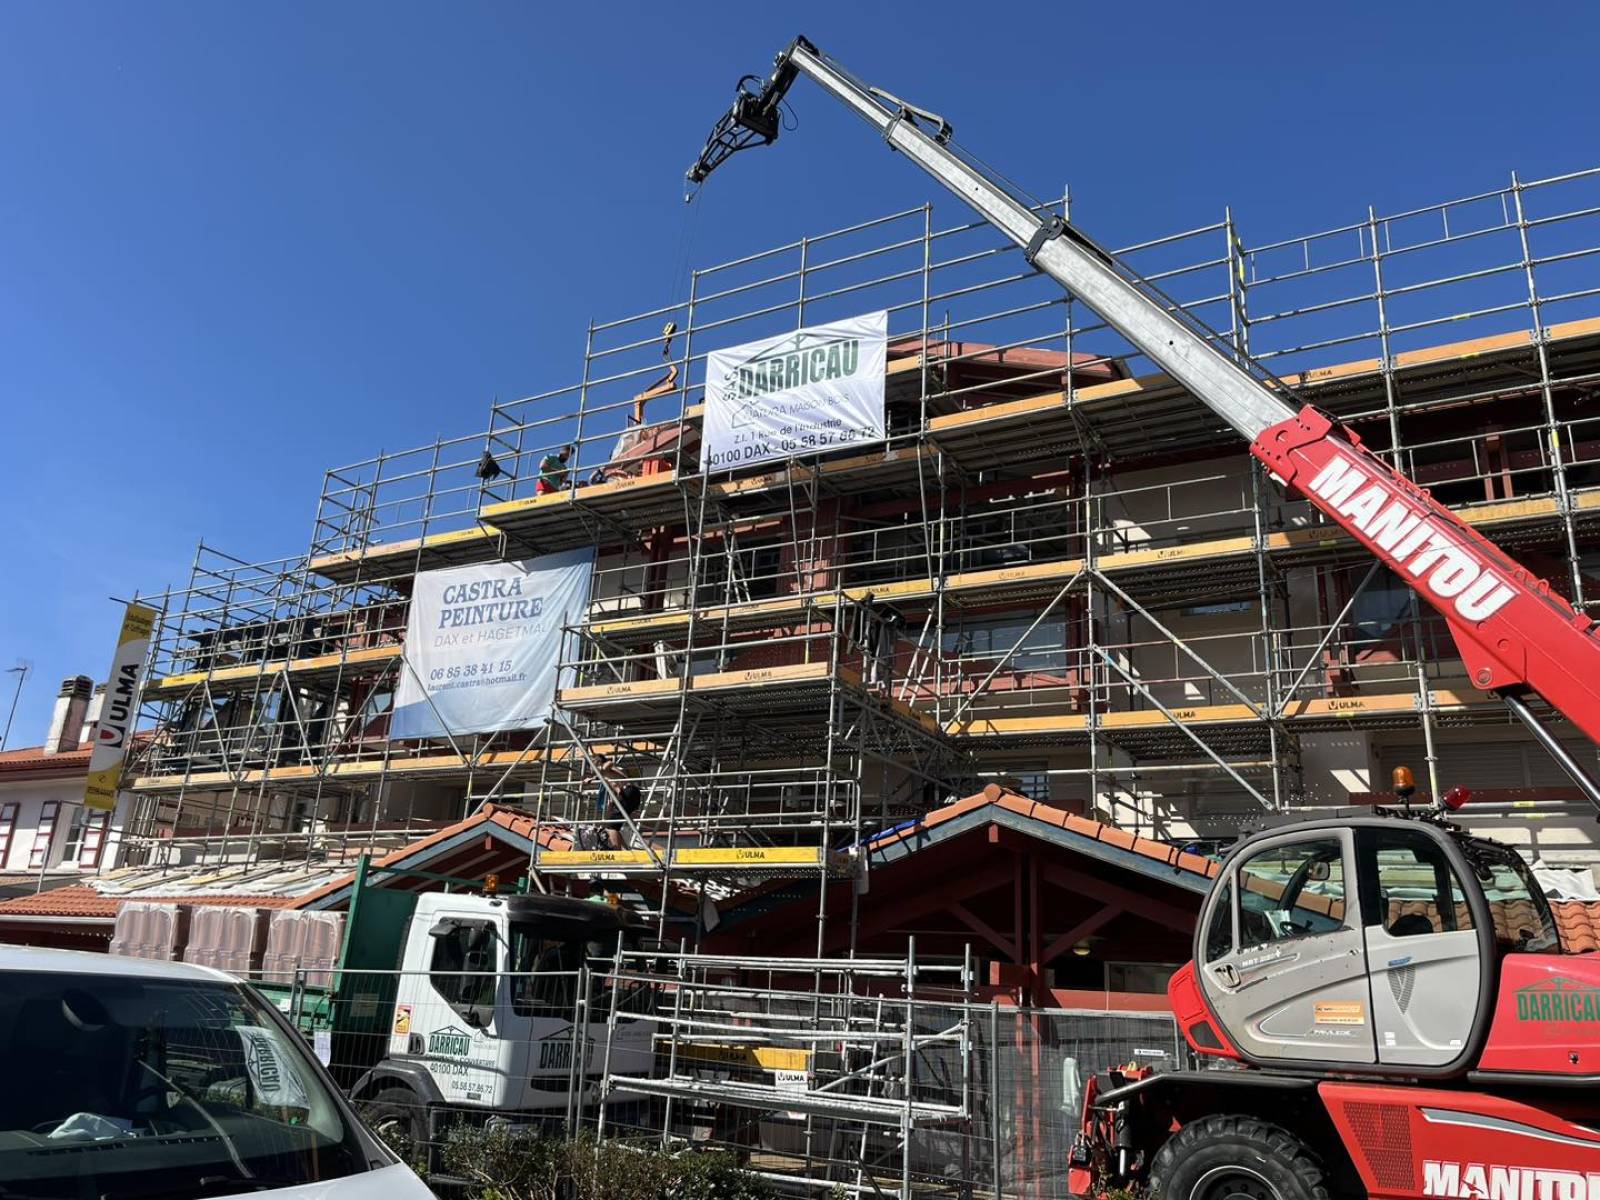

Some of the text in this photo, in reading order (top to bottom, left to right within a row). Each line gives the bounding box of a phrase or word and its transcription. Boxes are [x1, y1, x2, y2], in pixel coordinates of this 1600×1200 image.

[739, 340, 859, 400] DARRICAU
[780, 426, 792, 436] de
[744, 442, 771, 459] DAX
[781, 439, 797, 451] 05
[801, 435, 817, 448] 58
[819, 431, 834, 444] 57
[1308, 455, 1518, 622] MANITOU
[443, 577, 523, 605] CASTRA
[438, 597, 544, 629] PEINTURE
[434, 632, 460, 648] DAX
[462, 635, 474, 645] et
[430, 668, 445, 681] 06
[446, 666, 461, 680] 85
[463, 664, 478, 677] 38
[498, 660, 513, 673] 15
[751, 671, 773, 681] ULMA
[109, 663, 140, 722] ULMA
[613, 686, 632, 695] ULMA
[1339, 700, 1366, 709] ULMA
[596, 853, 615, 862] ULMA
[744, 851, 766, 860] ULMA
[428, 1035, 471, 1057] DARRICAU
[430, 1062, 469, 1077] 40100 DAX
[785, 1073, 805, 1082] ULMA
